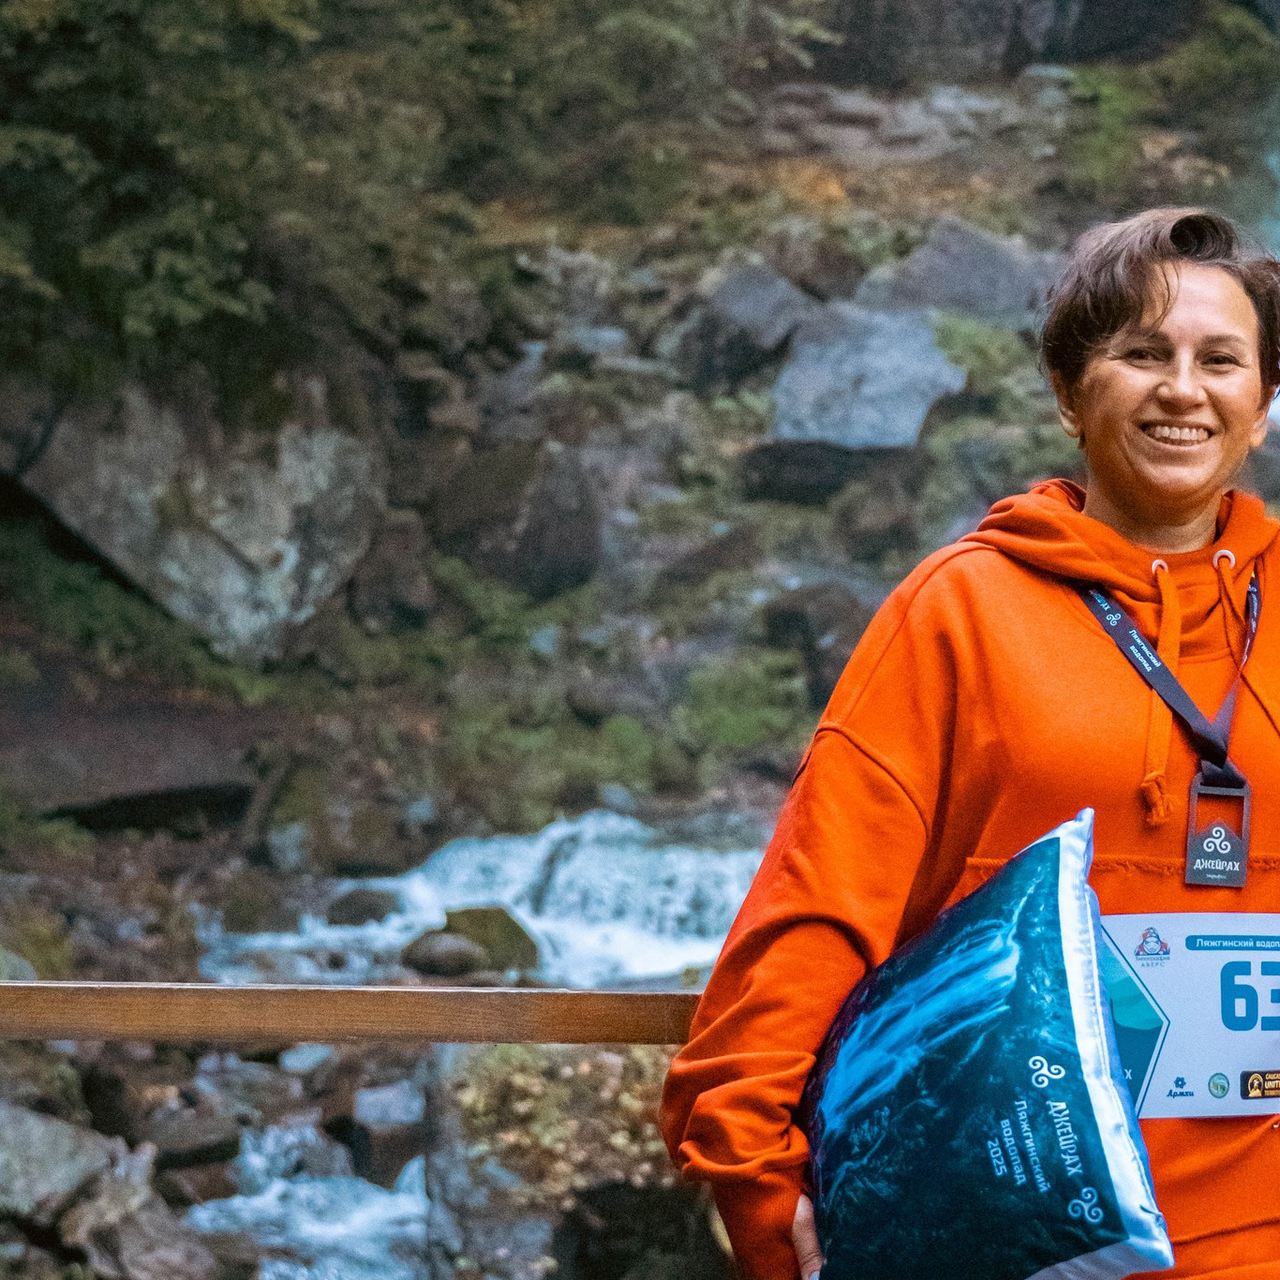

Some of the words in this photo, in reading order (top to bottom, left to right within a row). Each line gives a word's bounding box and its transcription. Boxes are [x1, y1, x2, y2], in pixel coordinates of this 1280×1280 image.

[1129, 629, 1161, 668] Ляжгинский
[1129, 645, 1152, 672] водопад
[1194, 858, 1240, 871] ДЖЕЙРАХ
[1196, 938, 1254, 948] Ляжгинский
[1166, 1089, 1194, 1099] Армхи
[987, 1137, 1008, 1176] 2025
[1001, 1118, 1027, 1185] водопад
[1015, 1100, 1051, 1193] Ляжгинский
[1046, 1100, 1083, 1176] ДЖЕЙРАХ
